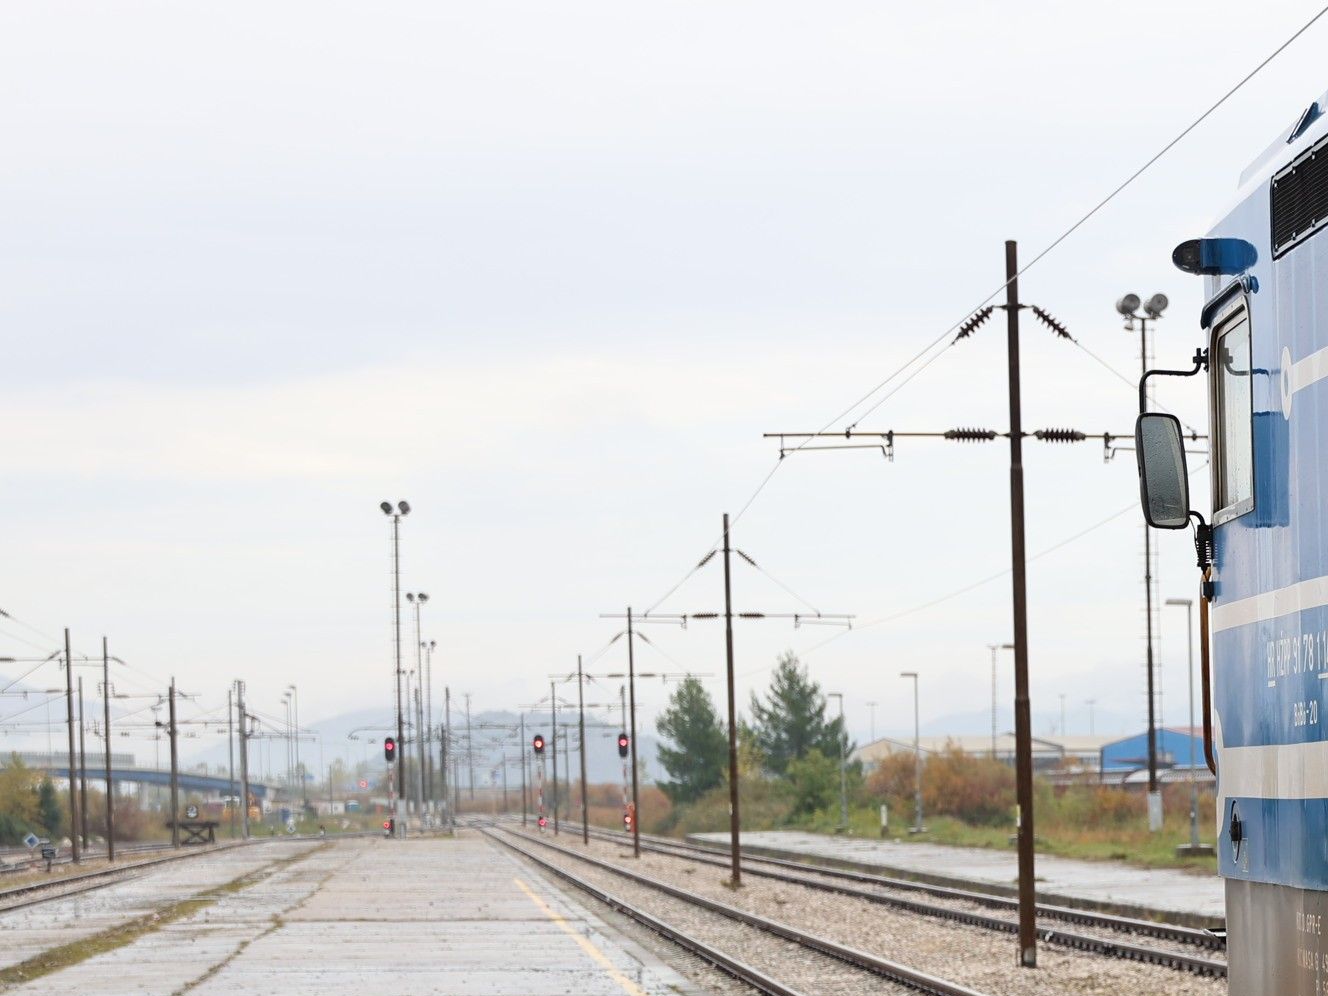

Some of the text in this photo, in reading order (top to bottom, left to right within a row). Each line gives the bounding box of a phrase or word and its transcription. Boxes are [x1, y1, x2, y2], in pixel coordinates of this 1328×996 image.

[1267, 641, 1276, 678] HR
[1292, 636, 1301, 674] 91
[1303, 634, 1314, 672] 78
